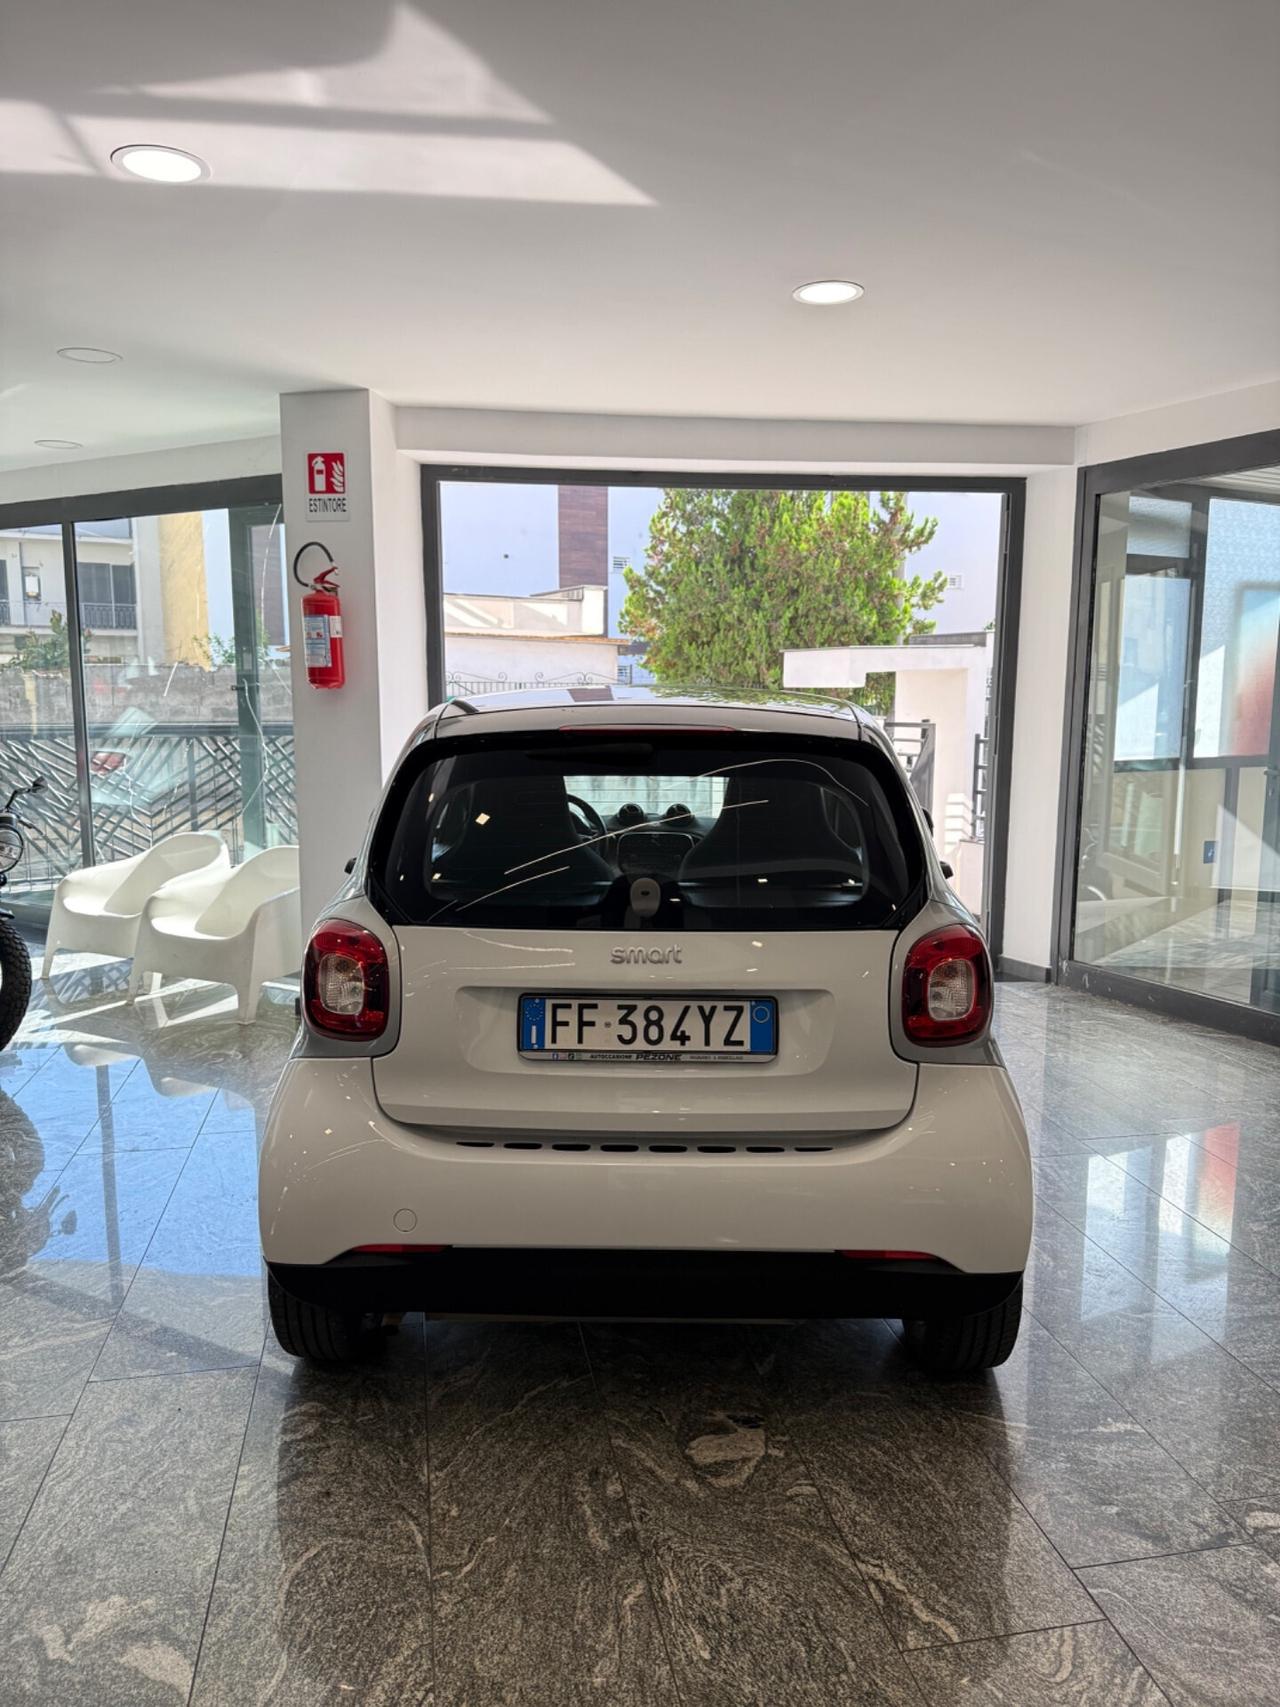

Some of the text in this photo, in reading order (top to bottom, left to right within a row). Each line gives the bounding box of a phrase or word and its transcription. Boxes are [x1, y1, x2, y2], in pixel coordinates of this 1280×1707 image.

[309, 498, 346, 512] ESTINTORE
[610, 944, 682, 964] smart
[551, 1003, 745, 1047] FF 384YZ
[635, 1052, 682, 1061] PEZONE
